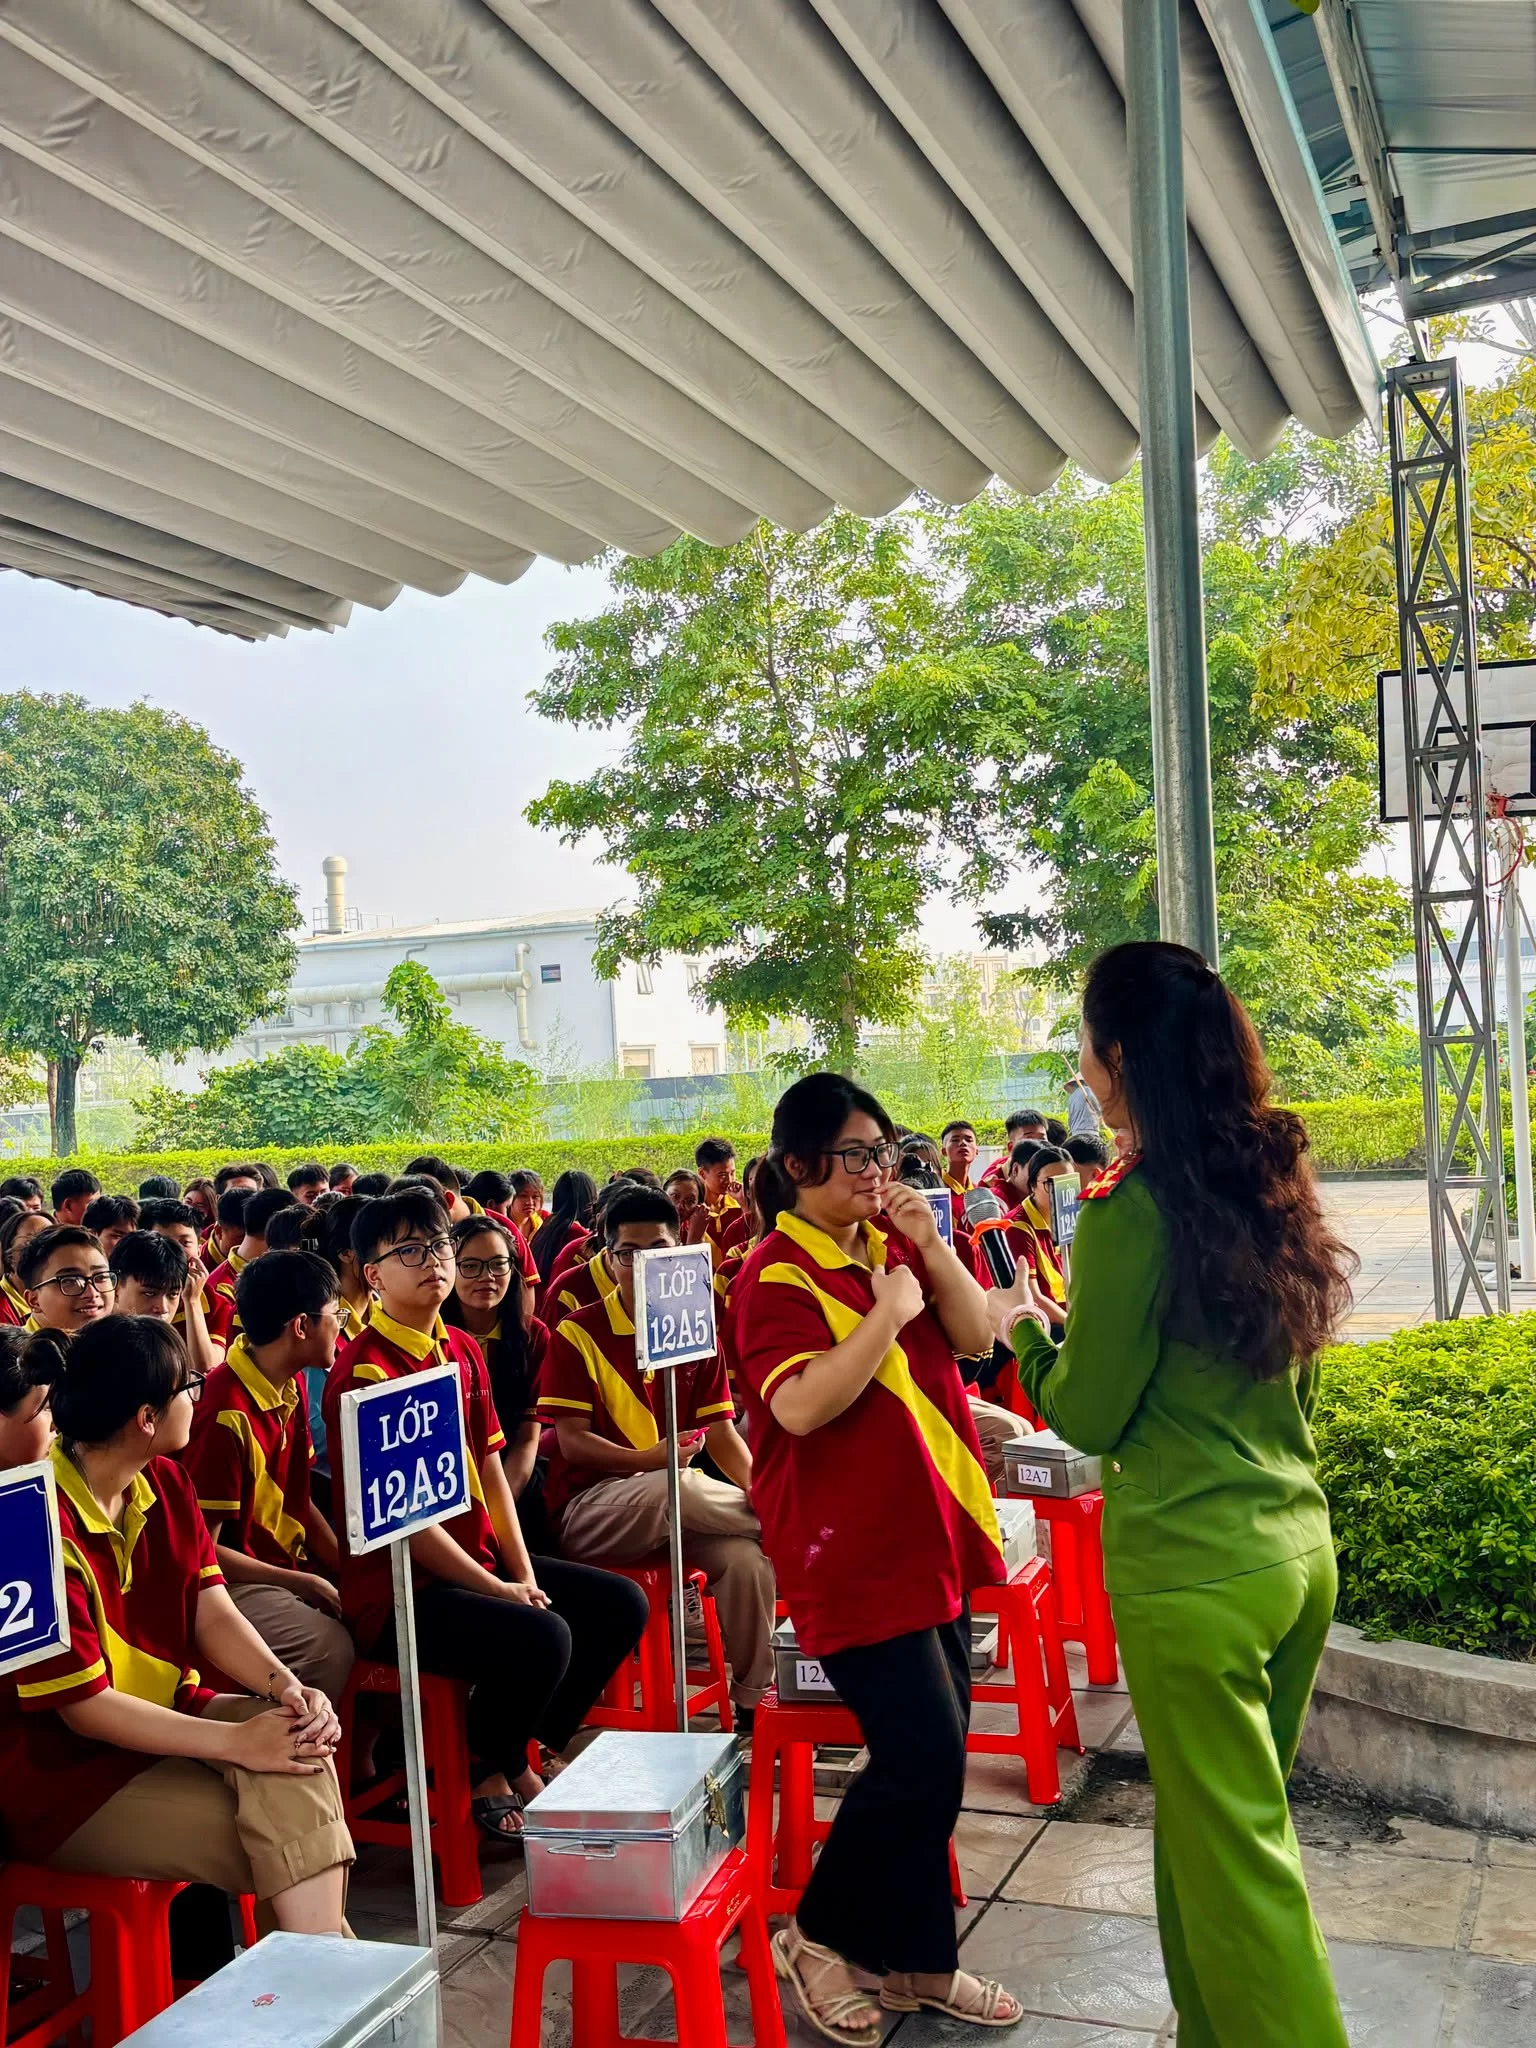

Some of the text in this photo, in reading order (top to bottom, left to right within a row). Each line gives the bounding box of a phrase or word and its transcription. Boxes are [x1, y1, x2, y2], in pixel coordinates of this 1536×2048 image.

[658, 1261, 697, 1299] LỚP
[650, 1308, 709, 1354] 12A5
[379, 1395, 439, 1452] LỚP
[367, 1451, 458, 1529] 12A3
[1020, 1468, 1049, 1484] 12A7
